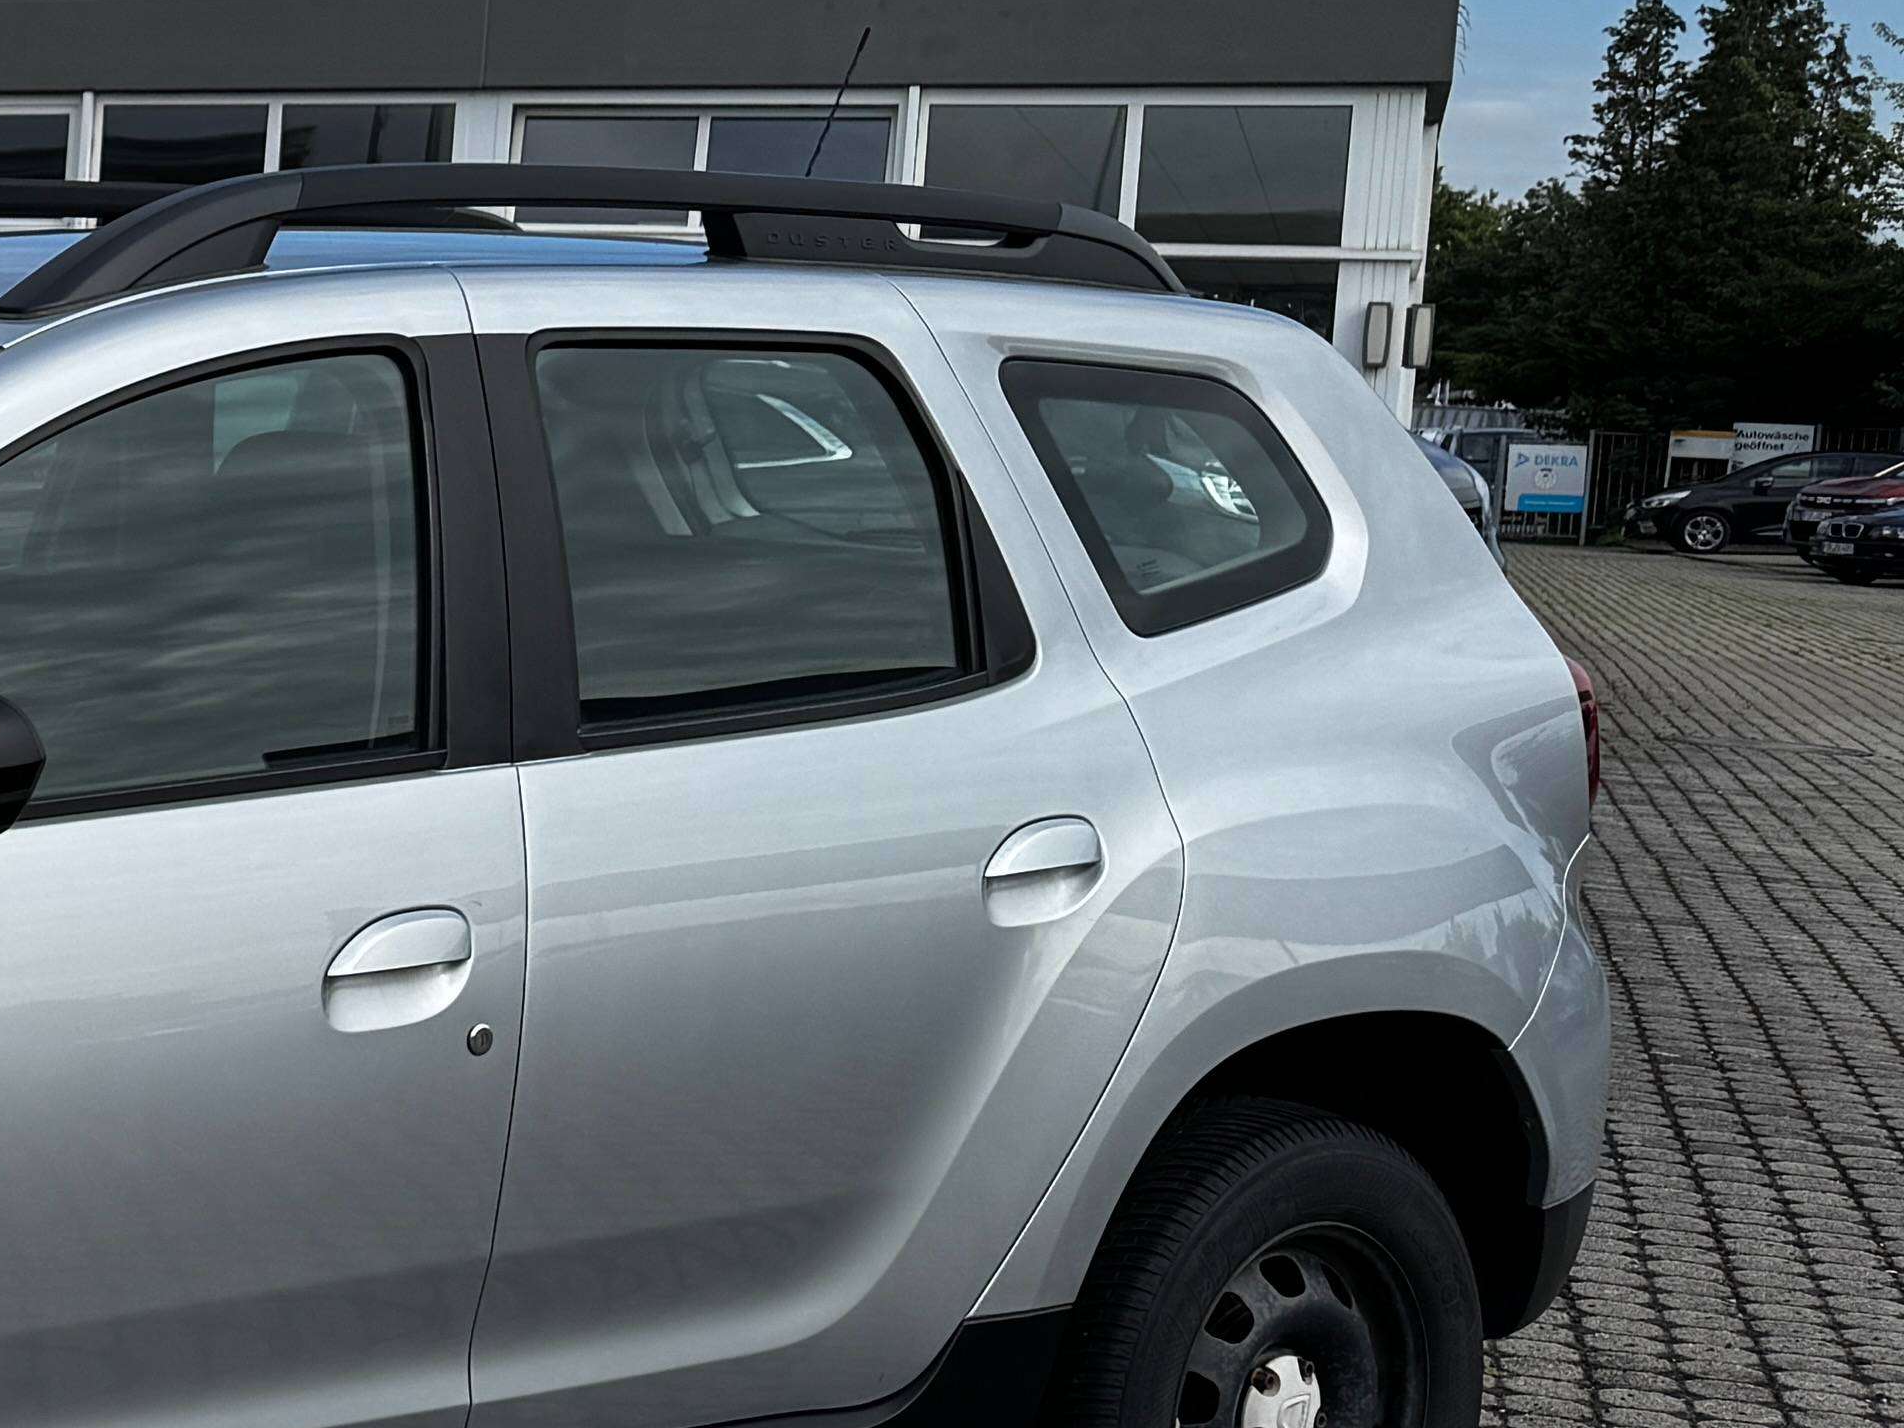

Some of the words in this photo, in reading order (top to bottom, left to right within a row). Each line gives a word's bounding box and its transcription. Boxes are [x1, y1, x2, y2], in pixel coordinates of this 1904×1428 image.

[767, 228, 898, 252] DUSTER
[1736, 430, 1810, 441] Autowäsche
[1735, 441, 1785, 452] geöffnet
[1534, 454, 1579, 467] DEKRA
